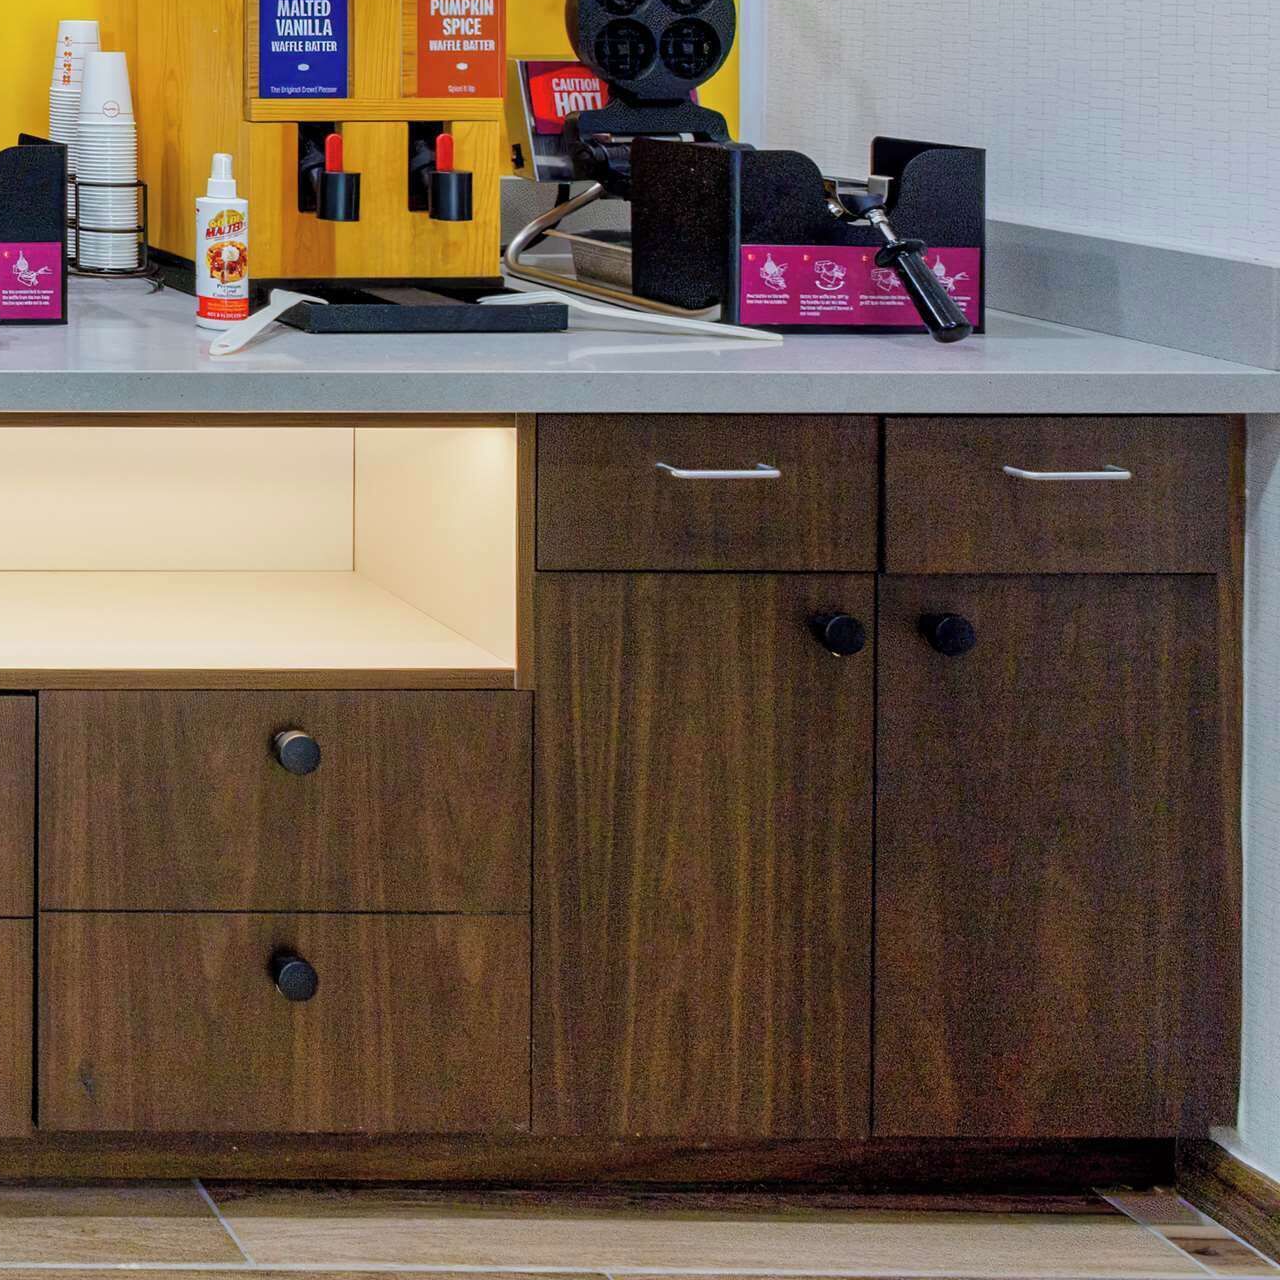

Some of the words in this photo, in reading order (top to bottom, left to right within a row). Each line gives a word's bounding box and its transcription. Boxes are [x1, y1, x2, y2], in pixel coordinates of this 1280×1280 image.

[277, 0, 332, 17] MALTED
[275, 18, 333, 36] VANILLA
[442, 17, 482, 36] SPICE
[271, 40, 304, 53] WAFFLE
[304, 40, 338, 53] BATTER
[428, 39, 462, 52] WAFFLE
[462, 39, 496, 52] BATTER
[551, 77, 601, 92] CAUTION
